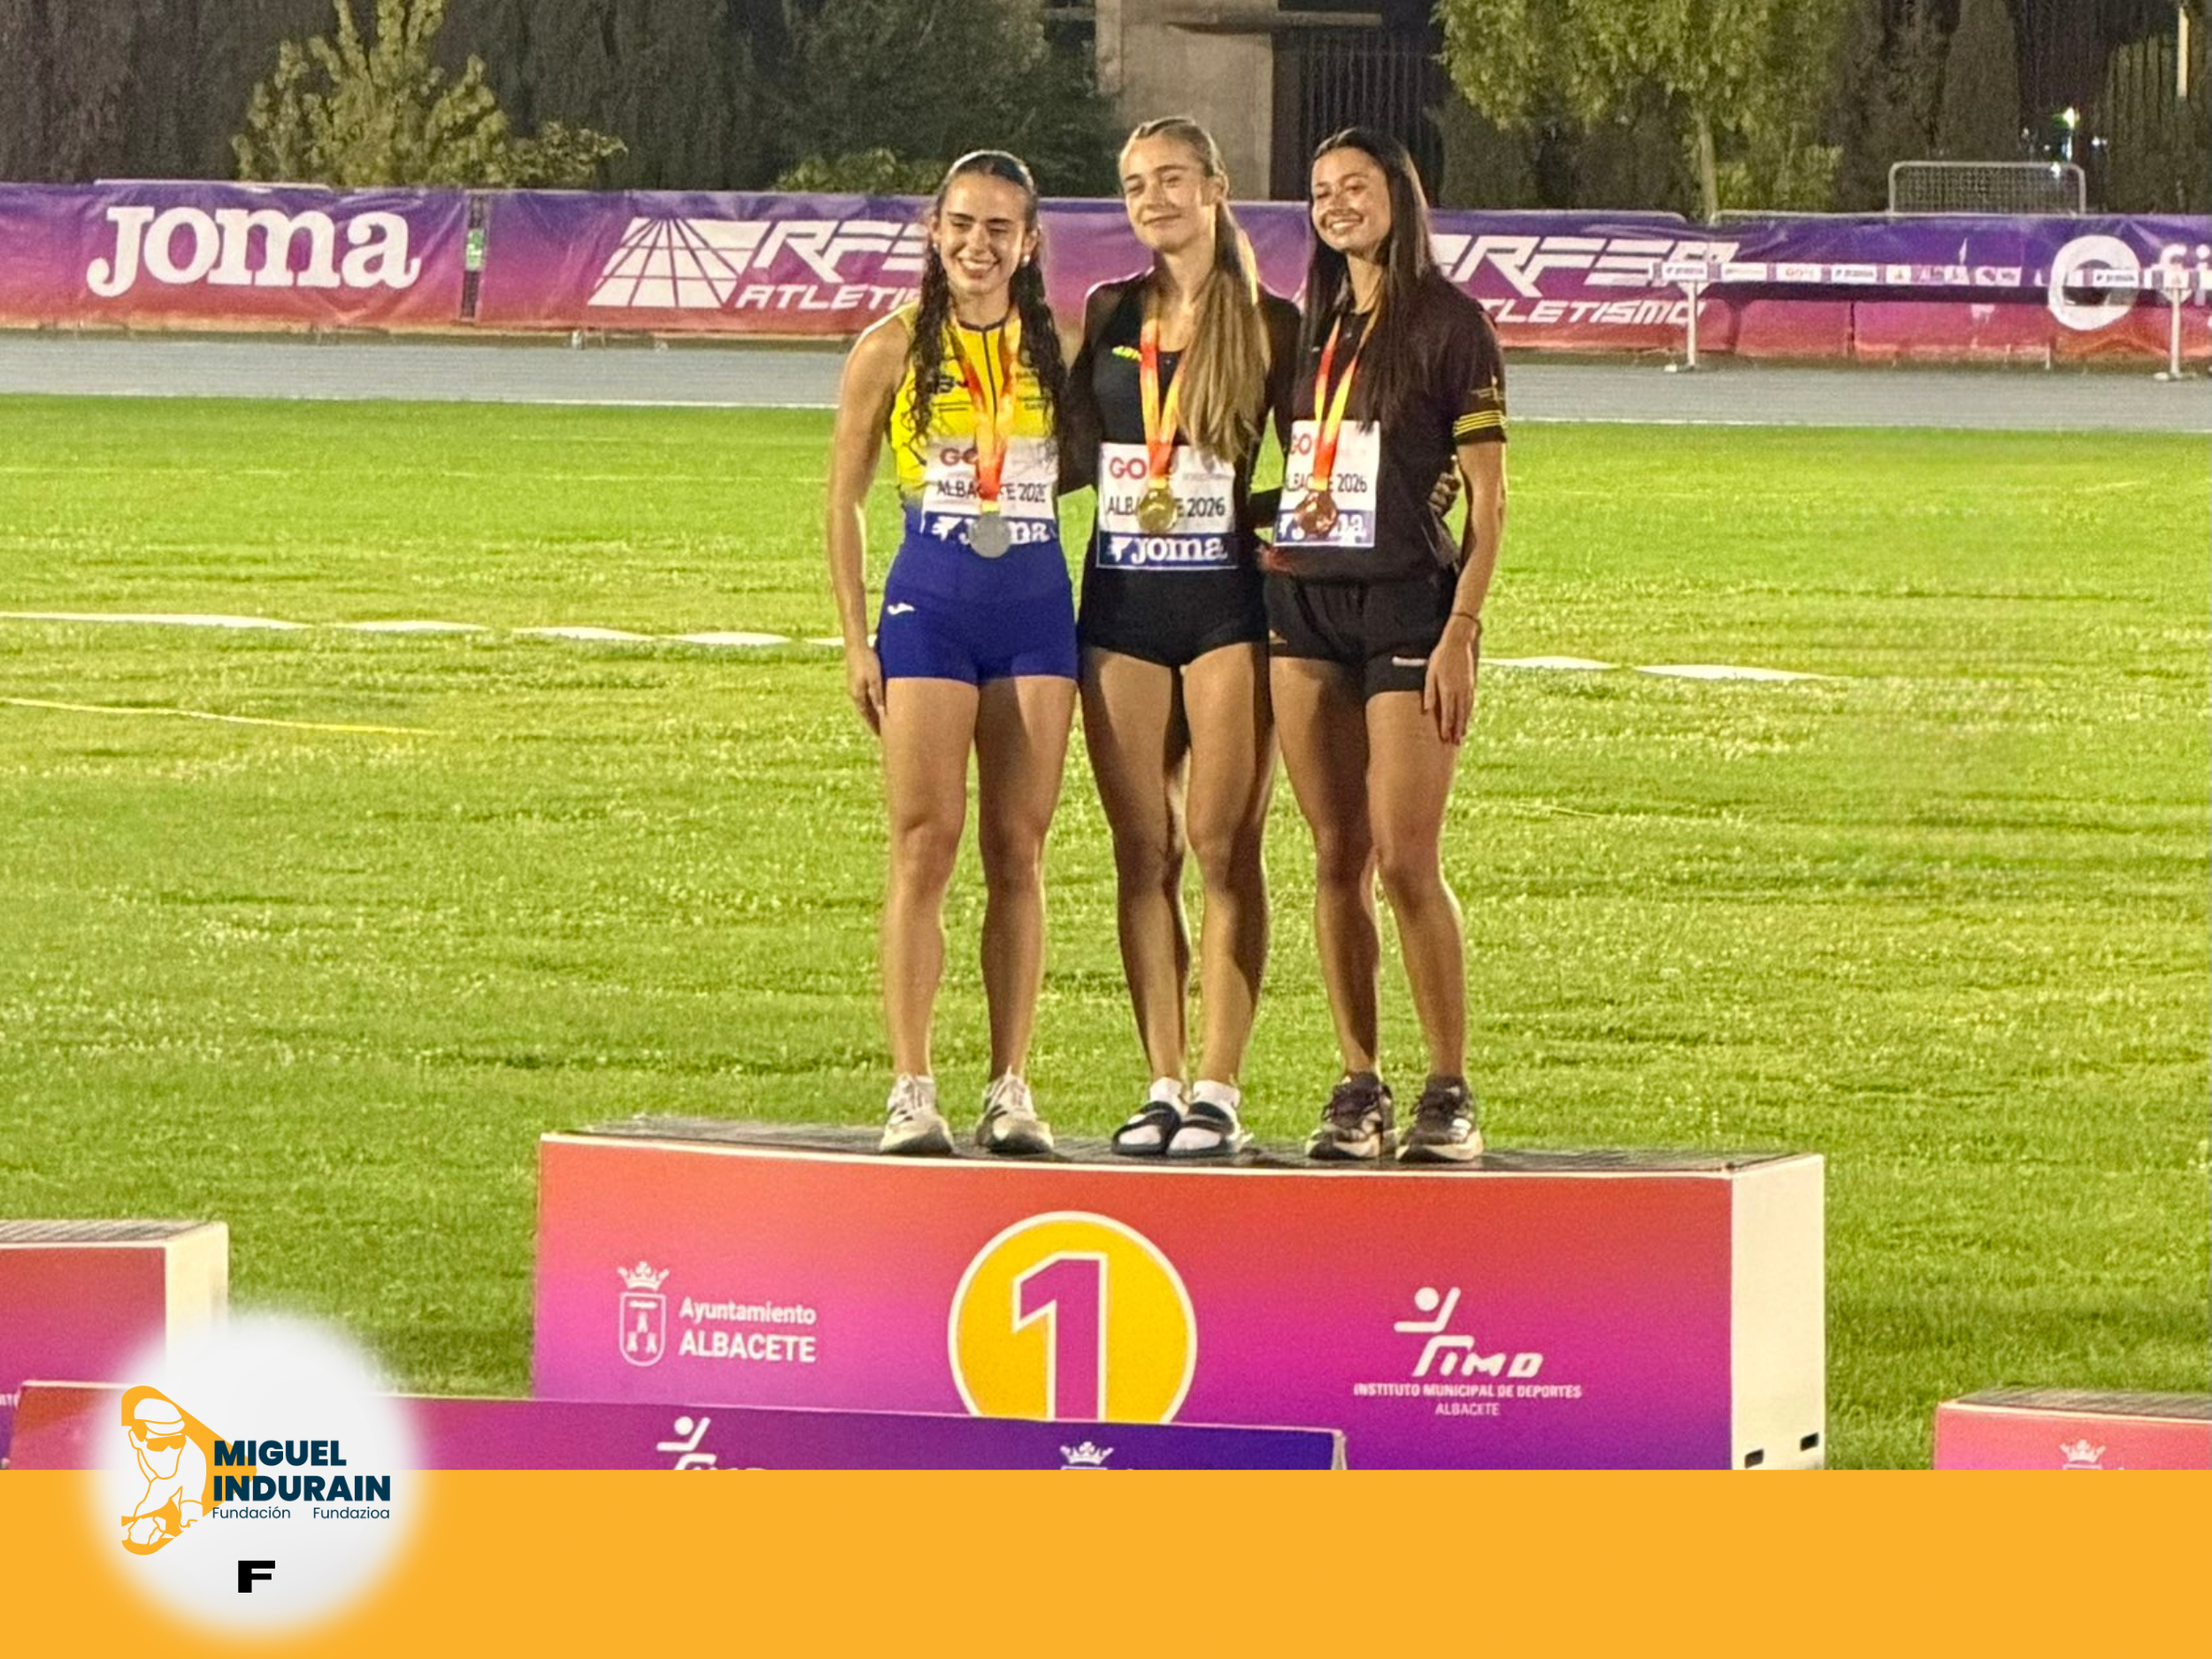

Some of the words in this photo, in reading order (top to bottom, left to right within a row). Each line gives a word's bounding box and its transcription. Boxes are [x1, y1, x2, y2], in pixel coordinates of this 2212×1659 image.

[1476, 298, 1706, 324] TLETISMO
[1110, 457, 1148, 480] GO
[1336, 473, 1368, 493] 2026
[1187, 497, 1226, 518] 2026
[679, 1296, 817, 1325] Ayuntamiento
[679, 1329, 817, 1363] ALBACETE
[1012, 1251, 1109, 1423] 1
[1354, 1383, 1420, 1396] INSTITUTO
[1423, 1384, 1494, 1398] MUNICIPAL
[1497, 1385, 1514, 1398] DE
[1517, 1385, 1582, 1399] DEPORTES
[1435, 1402, 1500, 1416] ALBACETE
